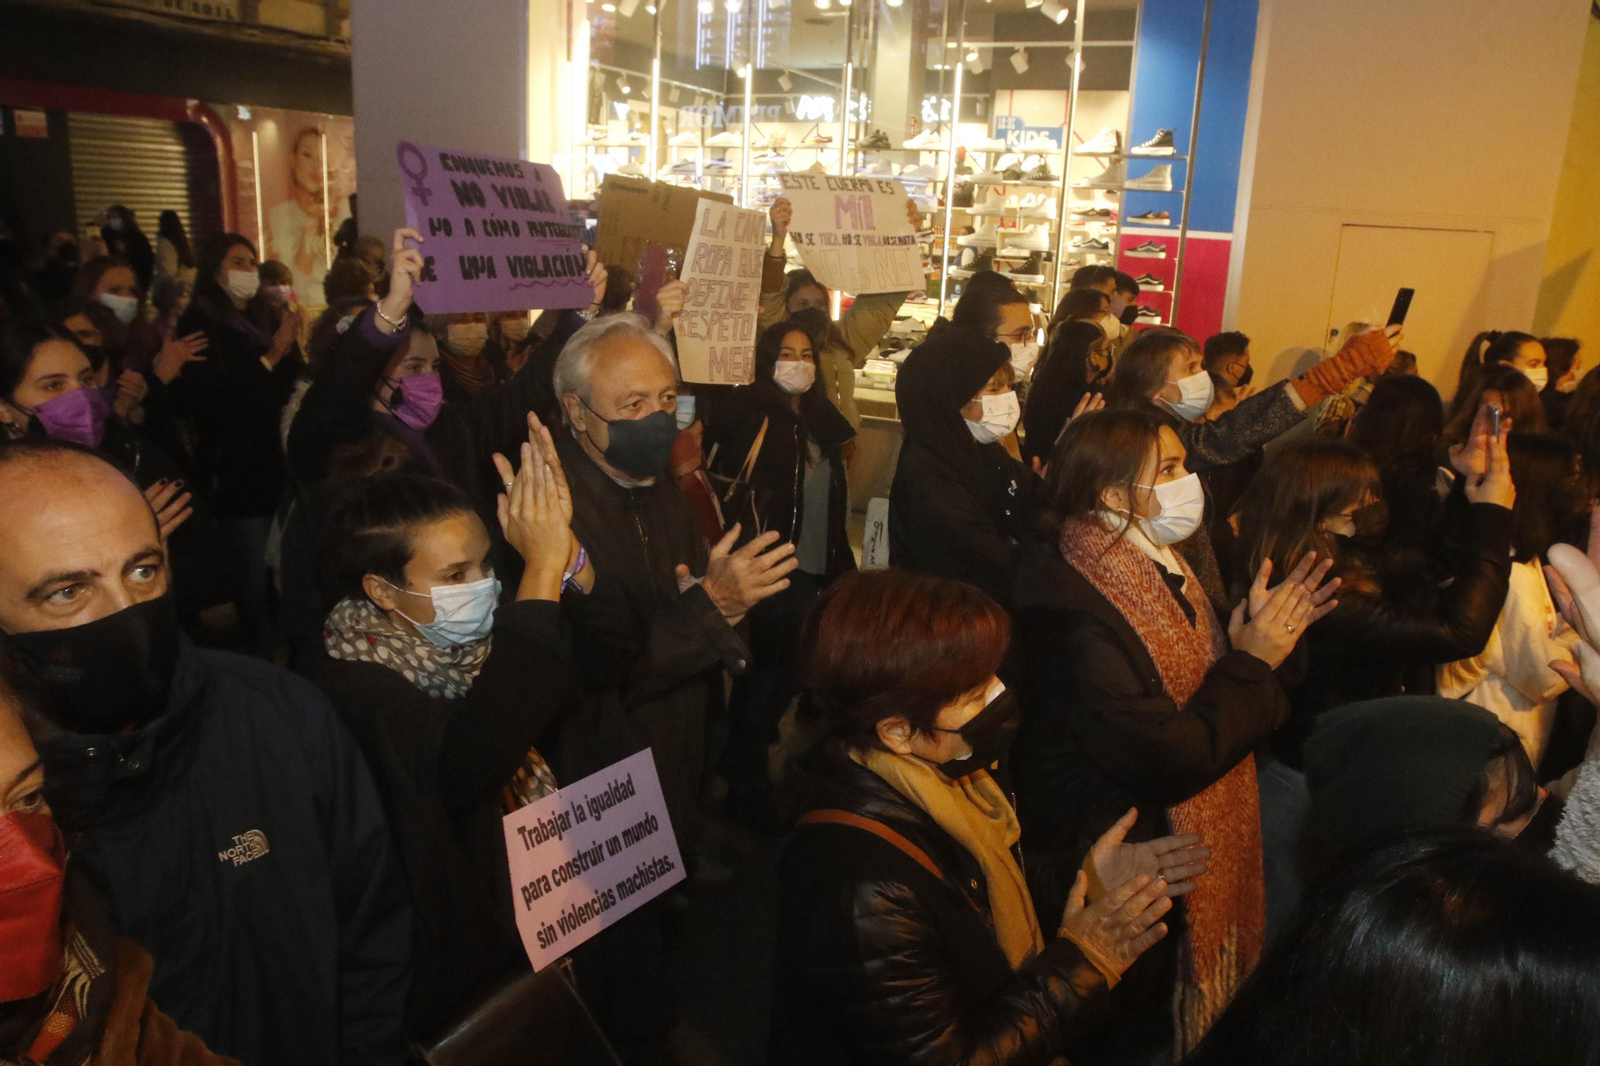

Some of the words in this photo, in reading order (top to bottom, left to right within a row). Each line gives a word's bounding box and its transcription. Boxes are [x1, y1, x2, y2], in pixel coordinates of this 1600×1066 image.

[534, 167, 543, 183] A
[779, 173, 821, 190] ESTE
[825, 176, 874, 193] CUERPO
[876, 180, 895, 195] ES
[451, 179, 486, 209] NO
[428, 217, 453, 237] NO
[464, 217, 477, 237] A
[700, 208, 727, 240] LA
[789, 231, 803, 246] NO
[805, 232, 816, 246] SE
[459, 255, 498, 280] UNA
[691, 242, 733, 277] ROPA
[737, 247, 763, 279] QUE
[850, 268, 871, 290] ES
[684, 277, 750, 311] DEFINE
[677, 310, 754, 342] RESPETO
[517, 808, 572, 851] Trabajar
[570, 801, 587, 825] la
[584, 772, 636, 821] igualdad
[231, 831, 254, 846] THE
[218, 842, 257, 863] NORTH
[232, 849, 260, 867] FACE
[520, 873, 552, 911] para
[551, 840, 605, 888] construir
[605, 834, 623, 857] un
[621, 812, 659, 849] mundo
[536, 921, 558, 950] sin
[556, 886, 617, 937] violencias
[615, 855, 675, 901] machistas.
